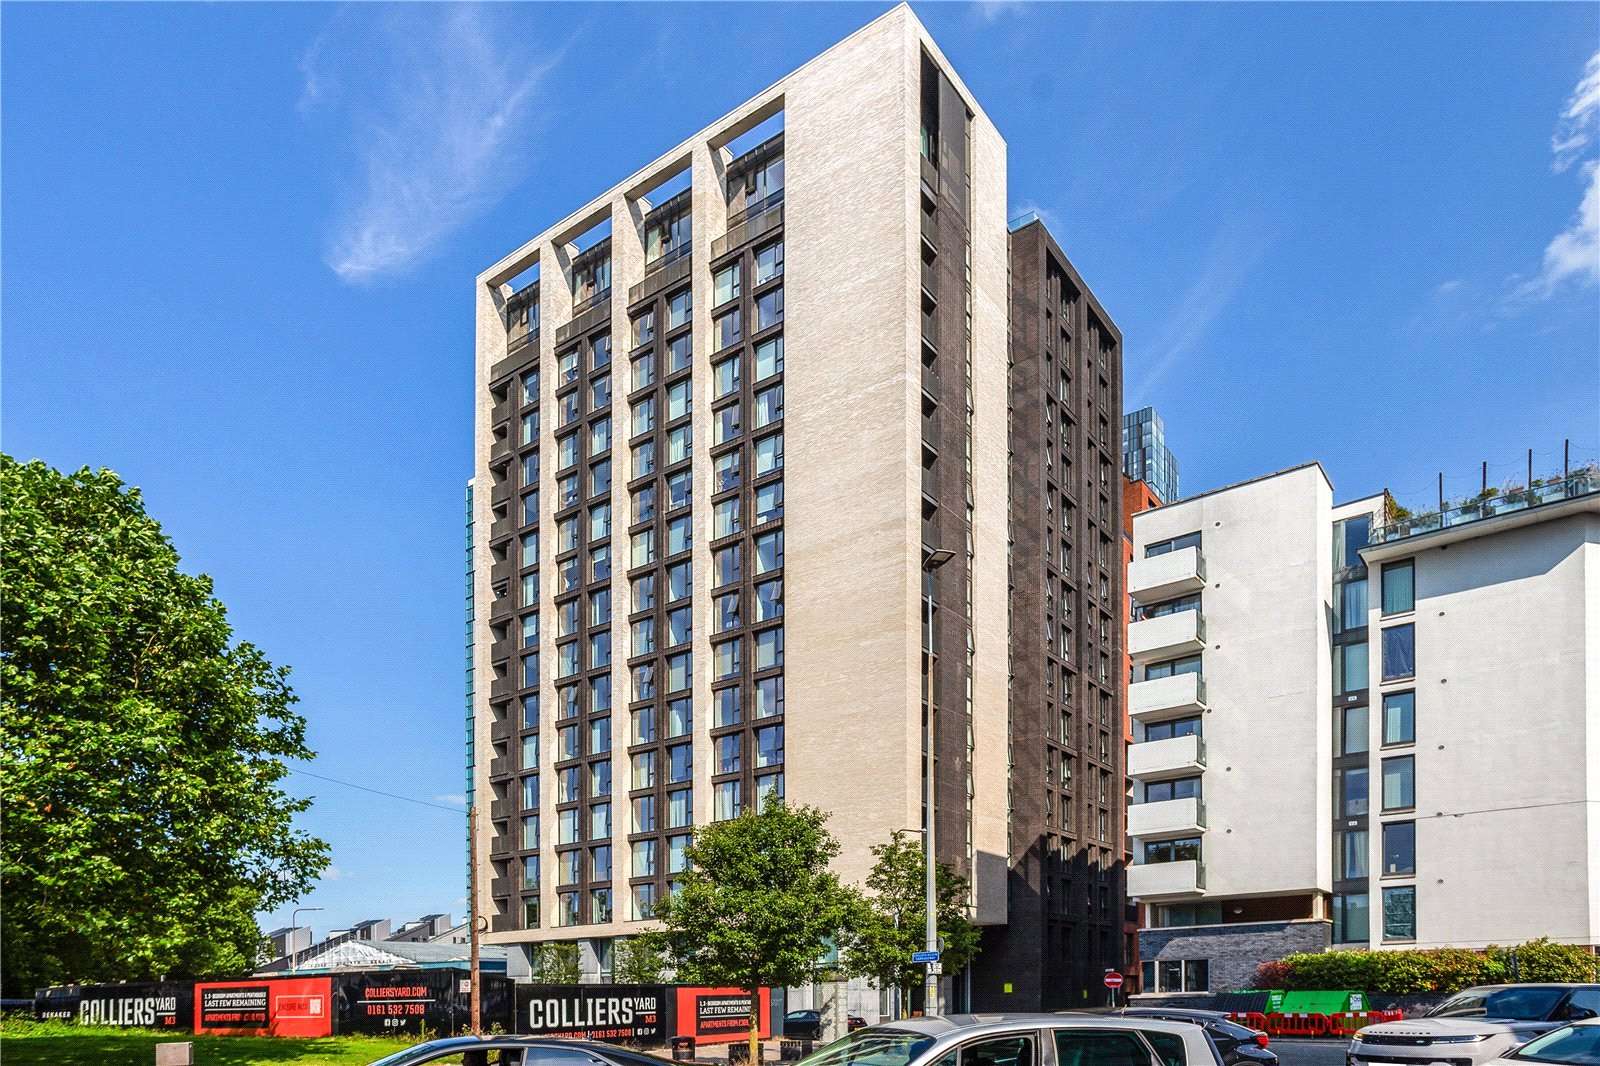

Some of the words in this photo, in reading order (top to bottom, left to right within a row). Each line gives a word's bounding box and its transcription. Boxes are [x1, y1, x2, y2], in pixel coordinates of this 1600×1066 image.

[365, 986, 427, 998] COLLIERSYARD.COM
[155, 997, 176, 1011] YARD
[231, 999, 266, 1007] REMAINING
[633, 997, 656, 1010] YARD
[80, 998, 155, 1025] COLLIERS
[367, 1005, 385, 1015] 0161
[388, 1004, 403, 1014] 532
[529, 997, 633, 1029] COLLIERS
[700, 1007, 714, 1015] LAST
[714, 1006, 727, 1014] FEW
[644, 1015, 656, 1023] M3
